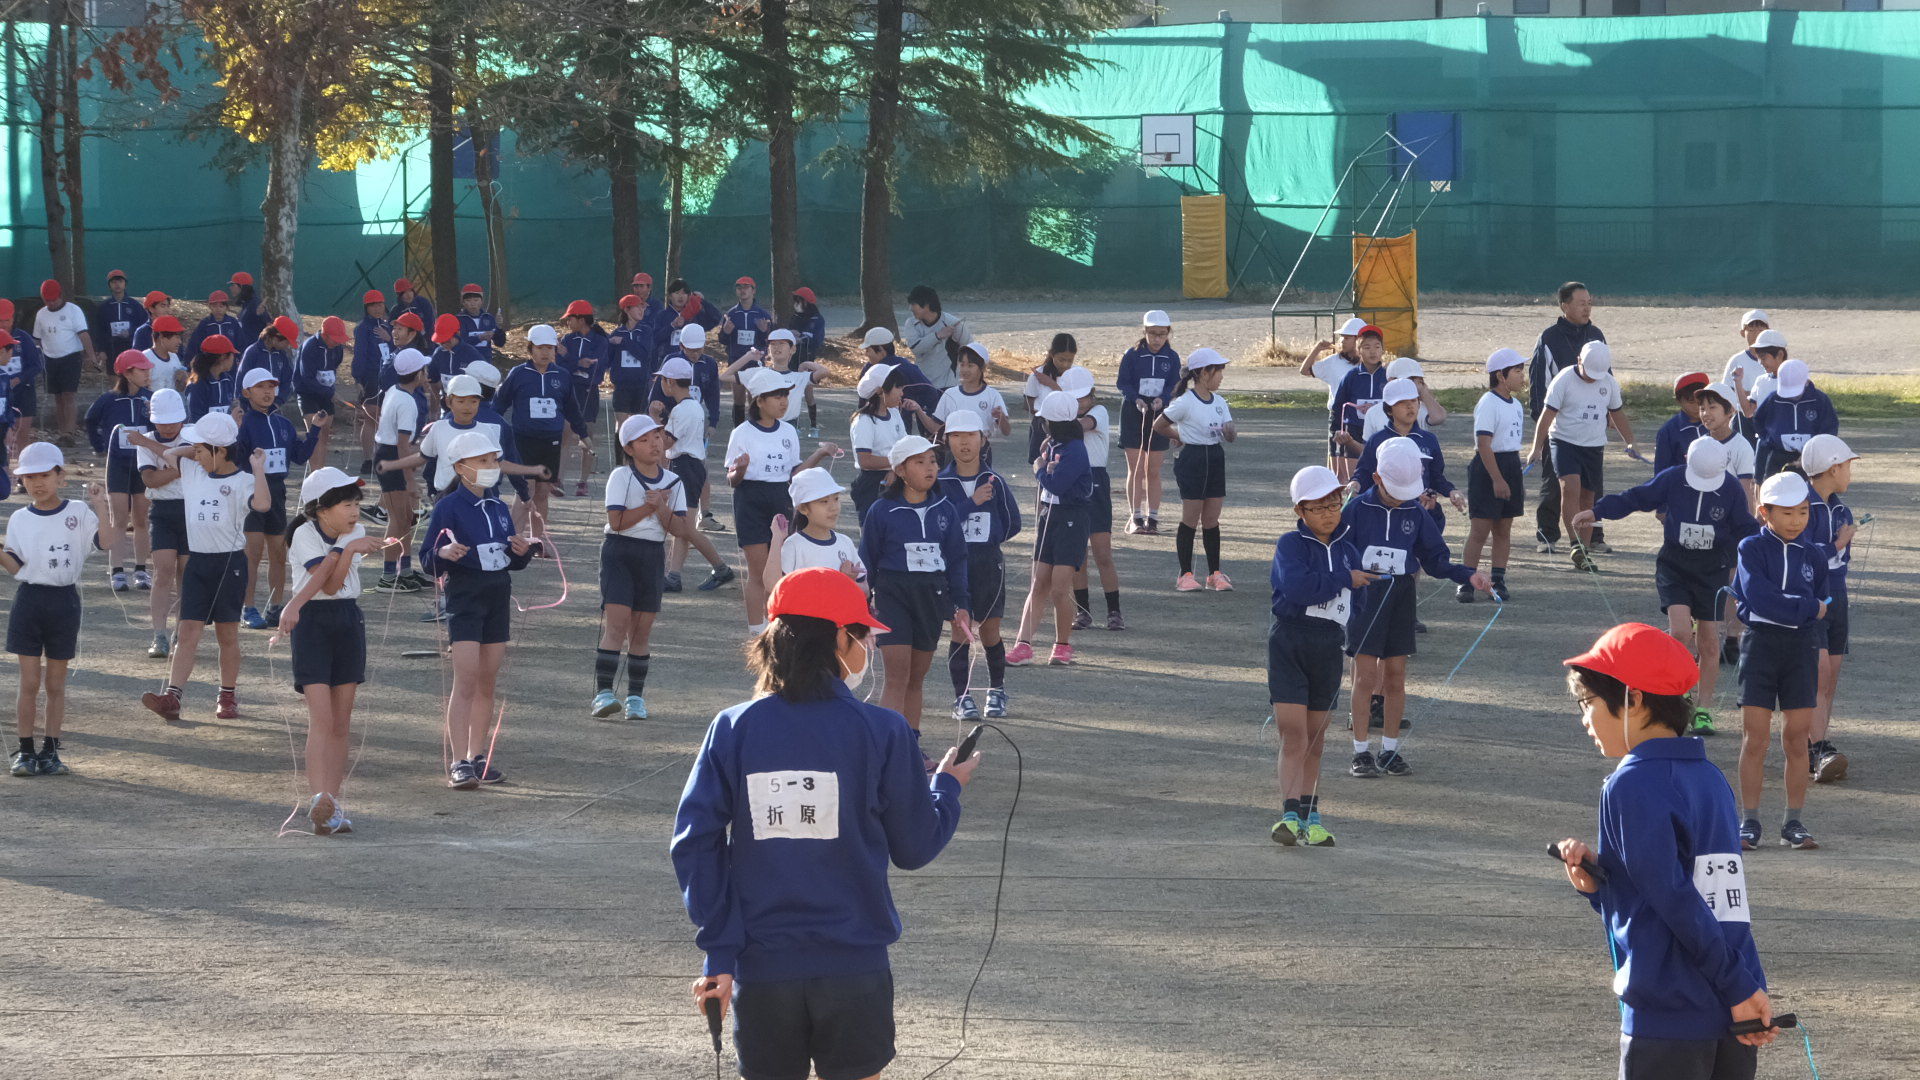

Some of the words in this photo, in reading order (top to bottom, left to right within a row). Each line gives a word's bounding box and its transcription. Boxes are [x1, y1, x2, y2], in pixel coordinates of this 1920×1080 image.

[200, 499, 219, 507] 4-2
[198, 512, 221, 522] 白石
[1685, 527, 1705, 537] 4-1
[48, 543, 71, 553] 4-2
[915, 546, 935, 554] 4-2
[1376, 550, 1395, 559] 4-1
[769, 776, 816, 793] 5-3
[766, 804, 817, 826] 折原
